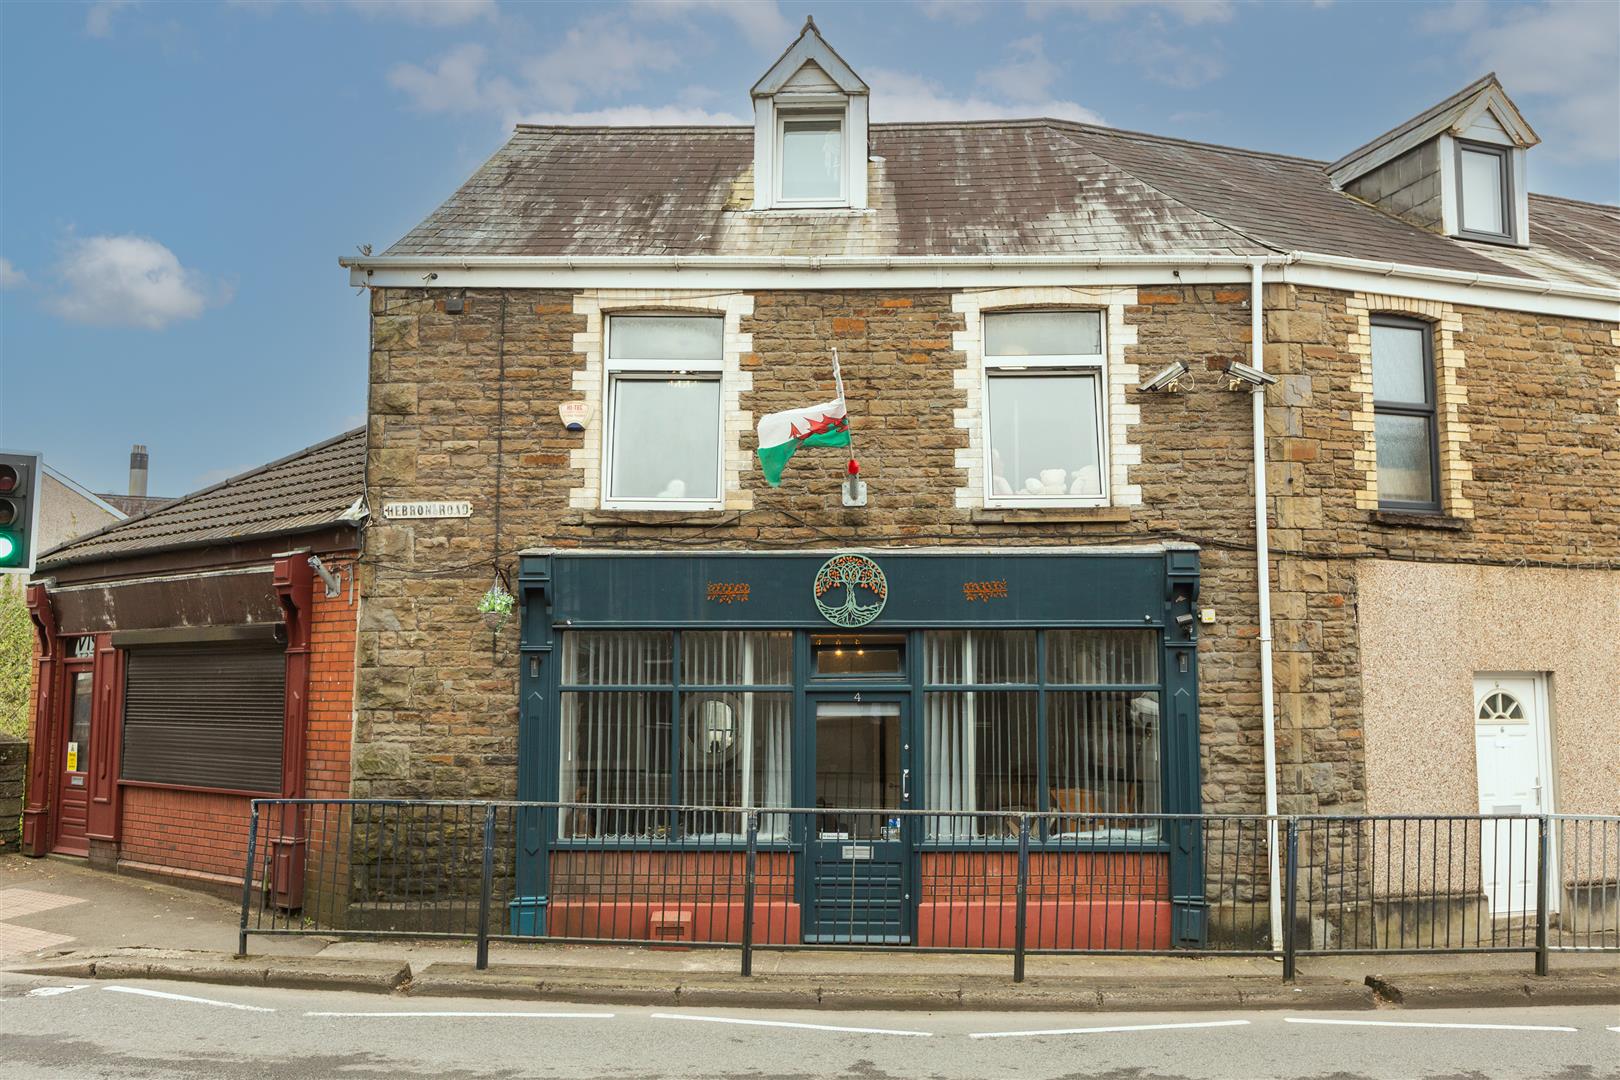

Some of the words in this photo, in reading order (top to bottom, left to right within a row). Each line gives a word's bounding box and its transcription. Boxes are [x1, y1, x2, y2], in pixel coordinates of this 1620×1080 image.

[387, 504, 432, 516] HEBRON
[439, 503, 469, 515] ROAD
[854, 692, 861, 702] 4
